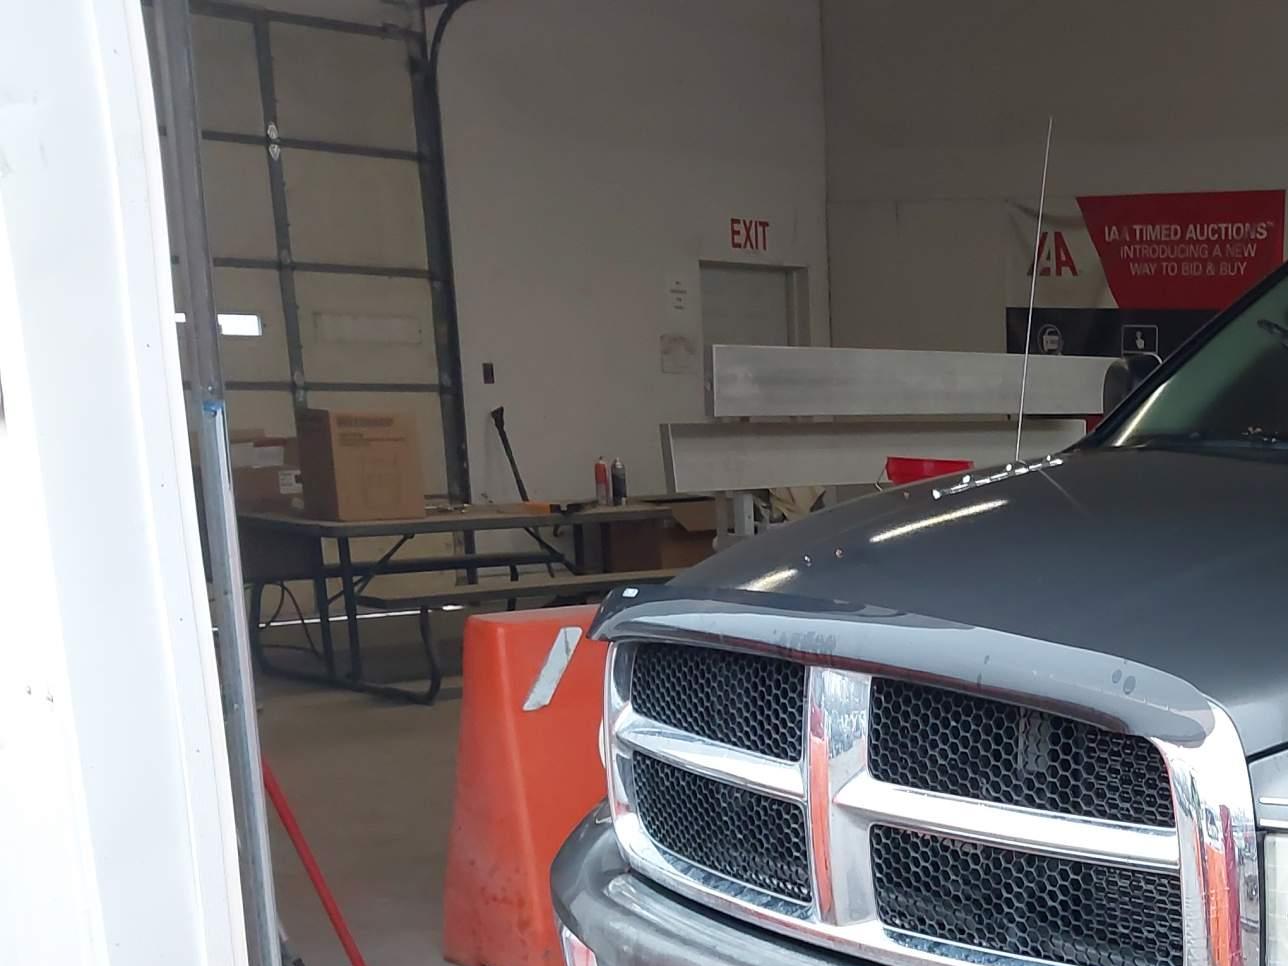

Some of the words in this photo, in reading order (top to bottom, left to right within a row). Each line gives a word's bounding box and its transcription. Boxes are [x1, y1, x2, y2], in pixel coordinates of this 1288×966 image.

[730, 218, 769, 250] EXIT
[1132, 224, 1181, 241] TIMED
[1120, 244, 1208, 260] INTRODUCING
[1212, 244, 1222, 257] A
[1226, 243, 1256, 258] NEW
[1129, 261, 1157, 276] WAY
[1162, 261, 1178, 276] TO
[1182, 261, 1202, 276] BID
[1206, 262, 1215, 276] &
[1220, 261, 1247, 276] BUY
